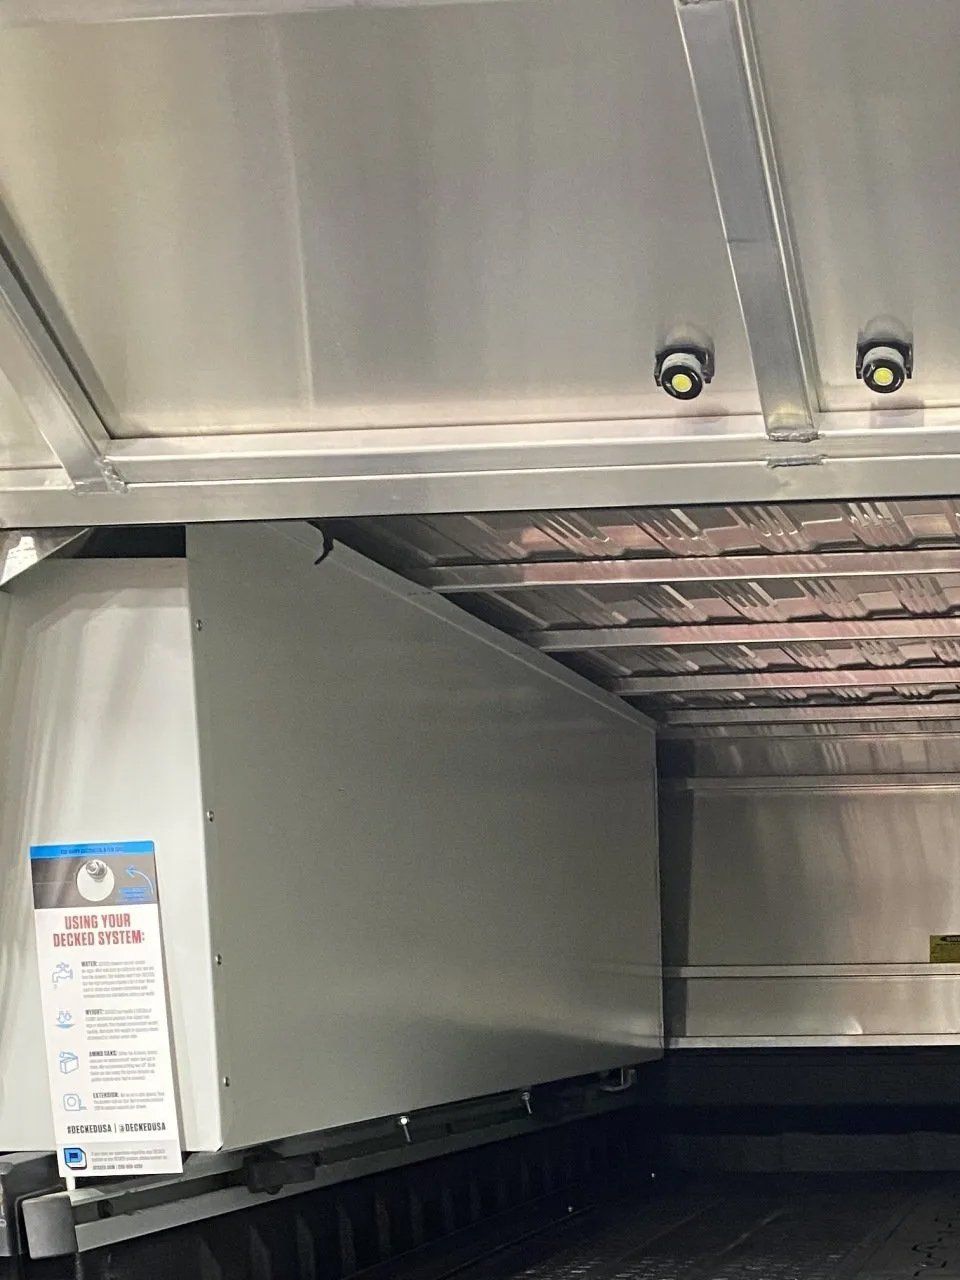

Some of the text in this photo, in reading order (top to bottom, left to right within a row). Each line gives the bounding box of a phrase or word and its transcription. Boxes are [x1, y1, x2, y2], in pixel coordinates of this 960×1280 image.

[64, 913, 131, 929] USING YOUR
[53, 930, 145, 947] DECKED SYSTEM:
